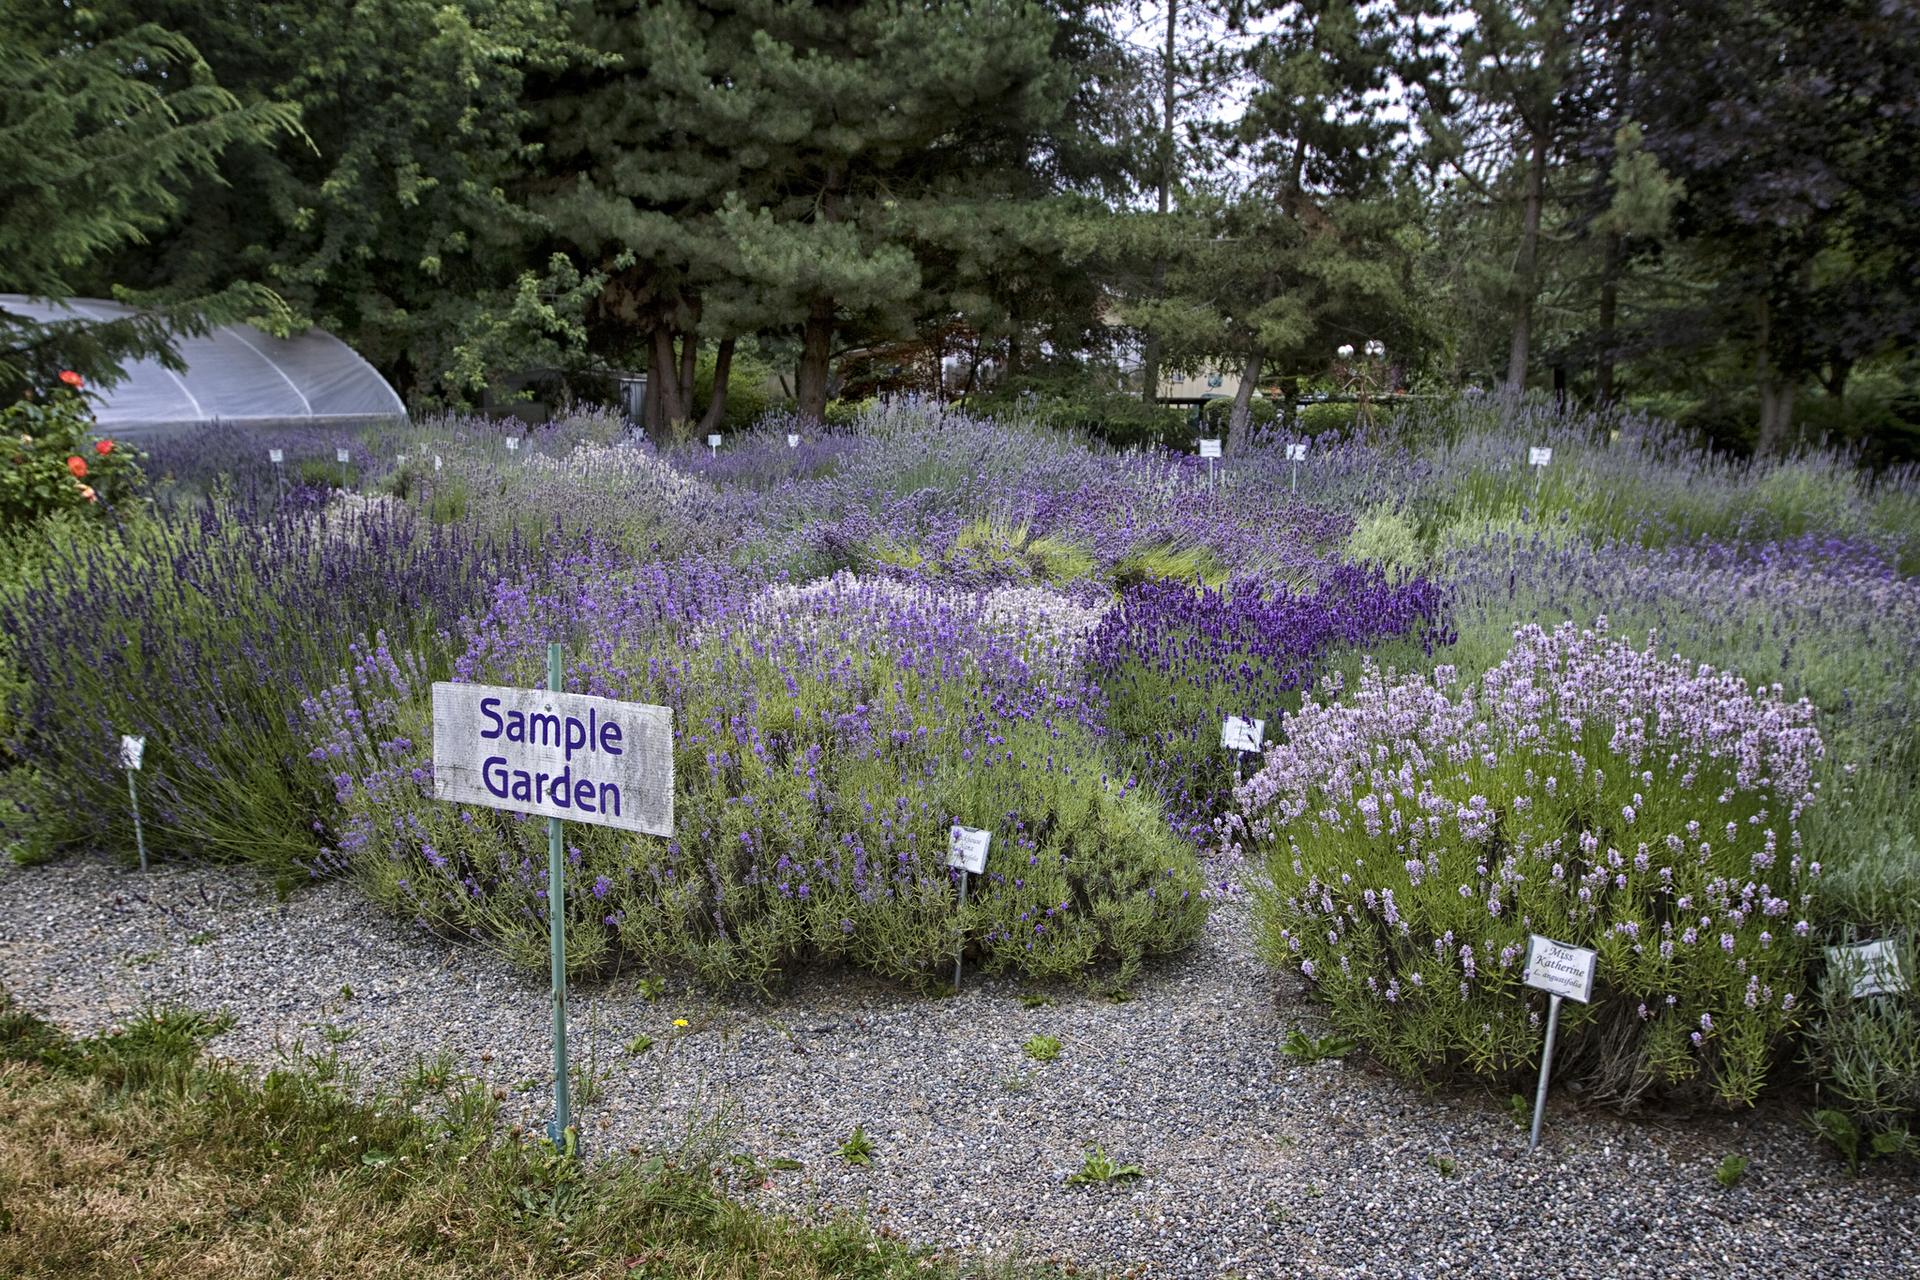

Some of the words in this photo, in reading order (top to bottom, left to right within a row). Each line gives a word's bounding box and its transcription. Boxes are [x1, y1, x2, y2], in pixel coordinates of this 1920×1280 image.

[480, 698, 623, 762] Sample
[482, 756, 621, 817] Garden
[1536, 955, 1584, 977] Katherine
[1542, 972, 1582, 988] angustifolia
